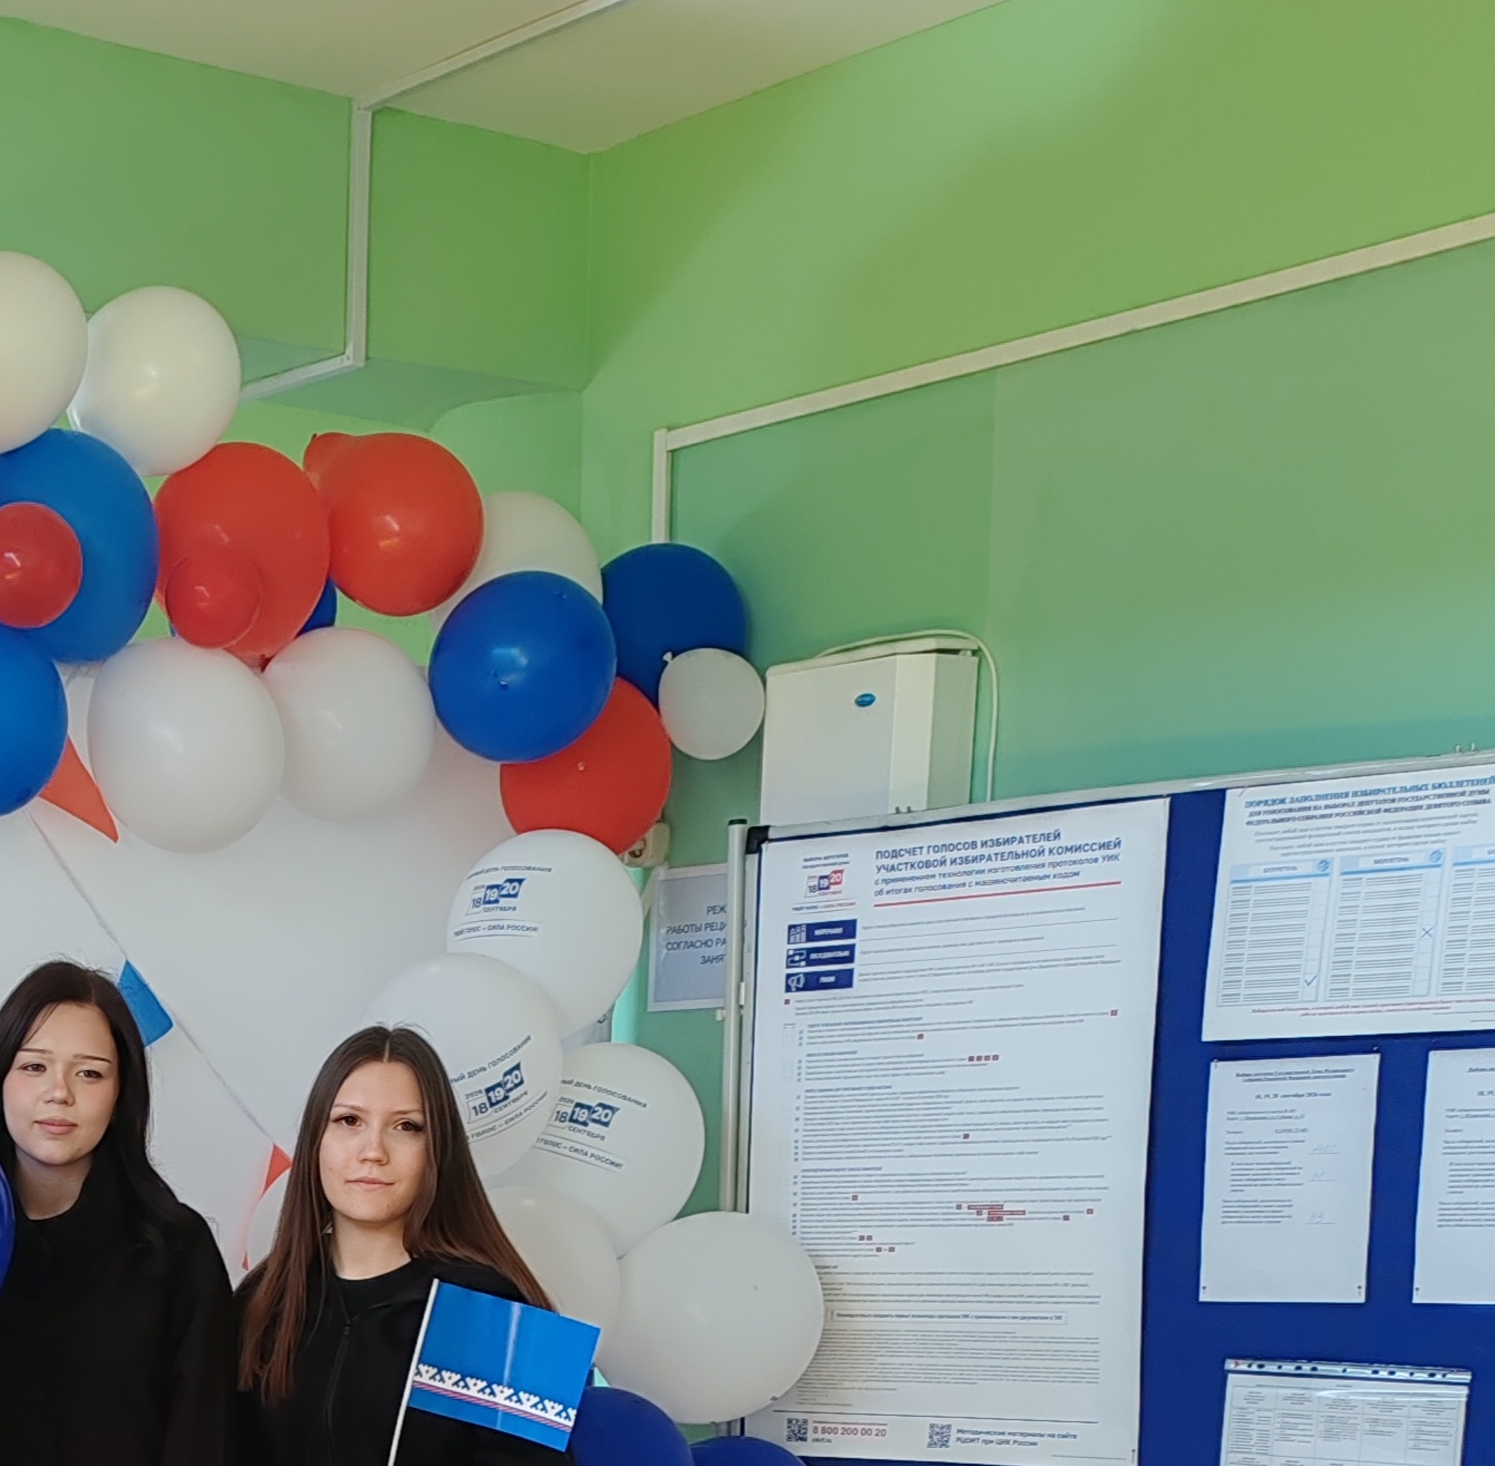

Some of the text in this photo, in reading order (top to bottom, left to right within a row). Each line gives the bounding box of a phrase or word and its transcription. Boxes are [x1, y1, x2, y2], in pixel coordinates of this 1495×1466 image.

[876, 828, 1061, 861] ПОДСЧЕТ ГОЛОСОВ ИЗБИРАТЕЛЕЙ
[875, 837, 1122, 875] УЧАСТКОВОЙ ИЗБИРАТЕЛЬНОЙ КОМИССИЕЙ
[938, 868, 986, 880] технологии
[987, 862, 1046, 875] изготовления
[1047, 857, 1099, 871] протоколов
[1101, 853, 1120, 864] УИК
[830, 871, 843, 883] 20
[471, 881, 519, 909] 18 19 20
[874, 887, 884, 897] об
[885, 886, 912, 896] итогах
[914, 881, 966, 893] голосования
[666, 922, 703, 935] РАБОТЫ
[665, 938, 714, 952] СОГЛАСНО
[467, 1066, 487, 1080] ДЕНЬ
[471, 1069, 522, 1117] 18 19 20
[593, 1085, 647, 1108] ГОЛОСОВАНИЯ
[553, 1106, 613, 1124] 18 19 20
[568, 1125, 606, 1142] СЕНТЯБРЯ
[568, 1145, 588, 1158] СИЛА
[812, 1425, 887, 1438] 8 800 200 00 20
